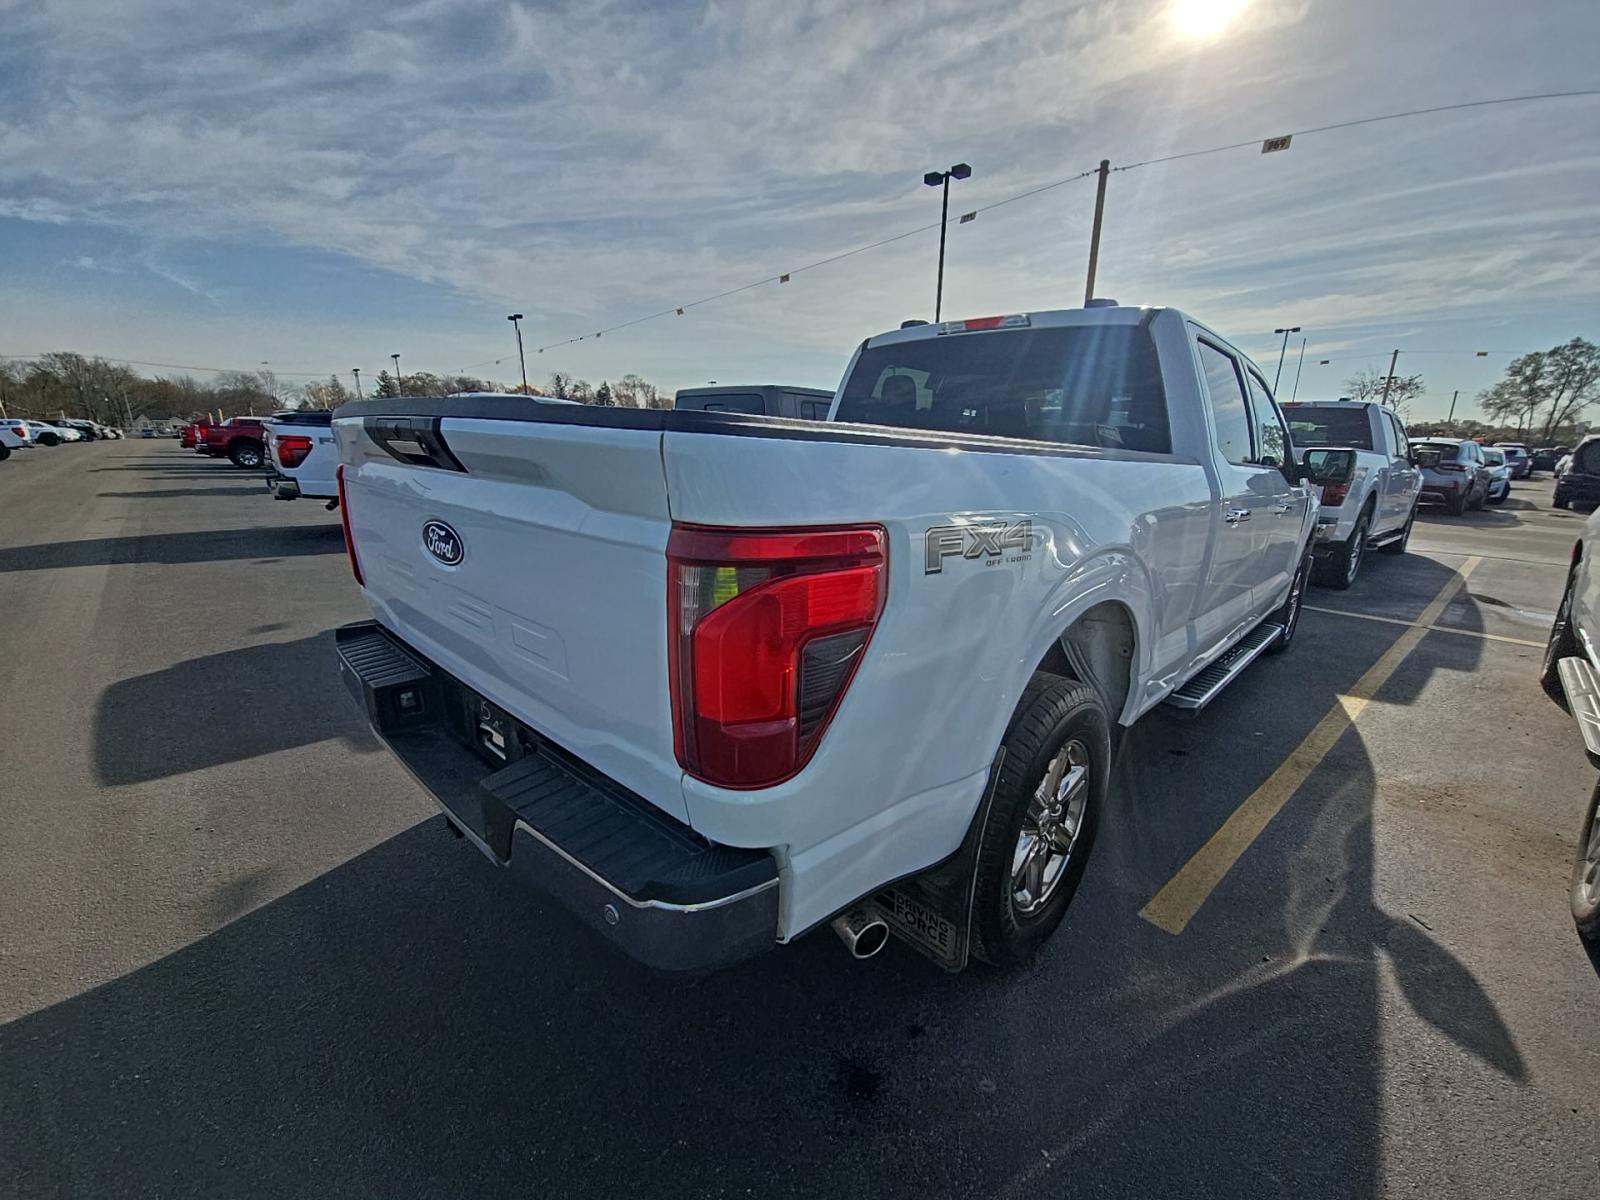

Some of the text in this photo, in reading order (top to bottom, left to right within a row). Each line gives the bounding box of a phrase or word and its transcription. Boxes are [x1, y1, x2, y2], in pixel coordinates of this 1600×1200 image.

[428, 526, 454, 559] Ford
[925, 520, 1032, 575] FX4
[985, 558, 1001, 567] OFF
[896, 904, 948, 947] FORCE
